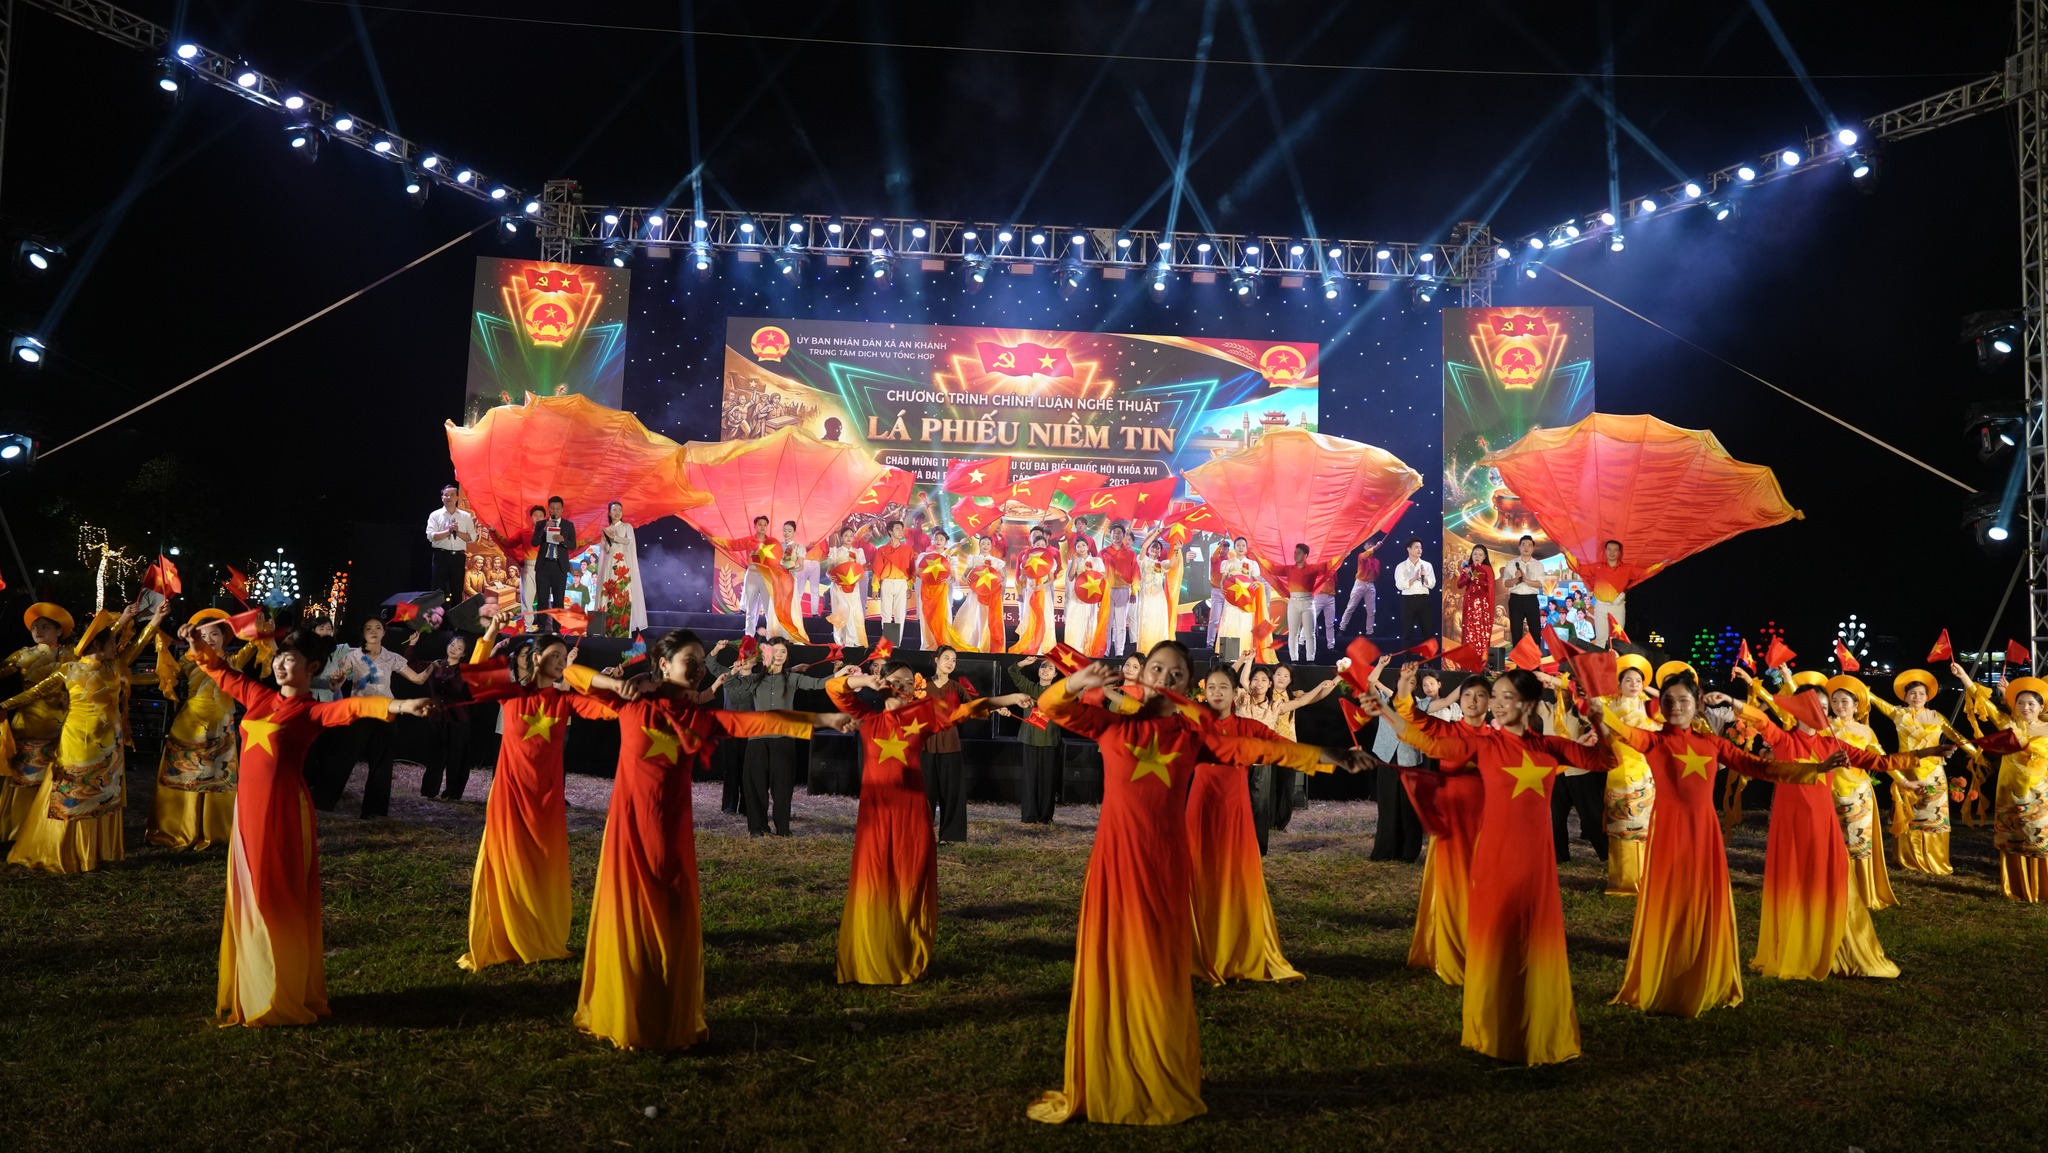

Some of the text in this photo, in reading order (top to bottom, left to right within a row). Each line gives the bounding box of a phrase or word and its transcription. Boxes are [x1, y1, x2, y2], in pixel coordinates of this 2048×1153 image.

[811, 337, 831, 345] BAN
[833, 336, 860, 346] NHÂN
[862, 337, 882, 347] DÂN
[884, 338, 897, 348] XÃ
[899, 340, 912, 349] AN
[914, 340, 947, 350] KHÁNH
[809, 348, 837, 356] TRUNG
[839, 348, 856, 357] TÂM
[858, 350, 878, 359] DỊCH
[880, 351, 891, 360] VỤ
[917, 352, 935, 361] HỢP
[886, 389, 1160, 415] CHƯƠNG TRÌNH CHÍNH LUẬN NGHỆ THUẬT
[867, 409, 1177, 452] LÁ PHIẾU NIỀM TIN
[885, 454, 910, 466] CHÀO
[912, 455, 939, 467] MỪNG
[1020, 458, 1033, 471] CỬ
[1100, 462, 1115, 476] HỘI
[1117, 463, 1141, 475] KHÓA
[1143, 466, 1158, 476] XVI
[1109, 478, 1130, 487] 2031
[1056, 595, 1063, 604] 3
